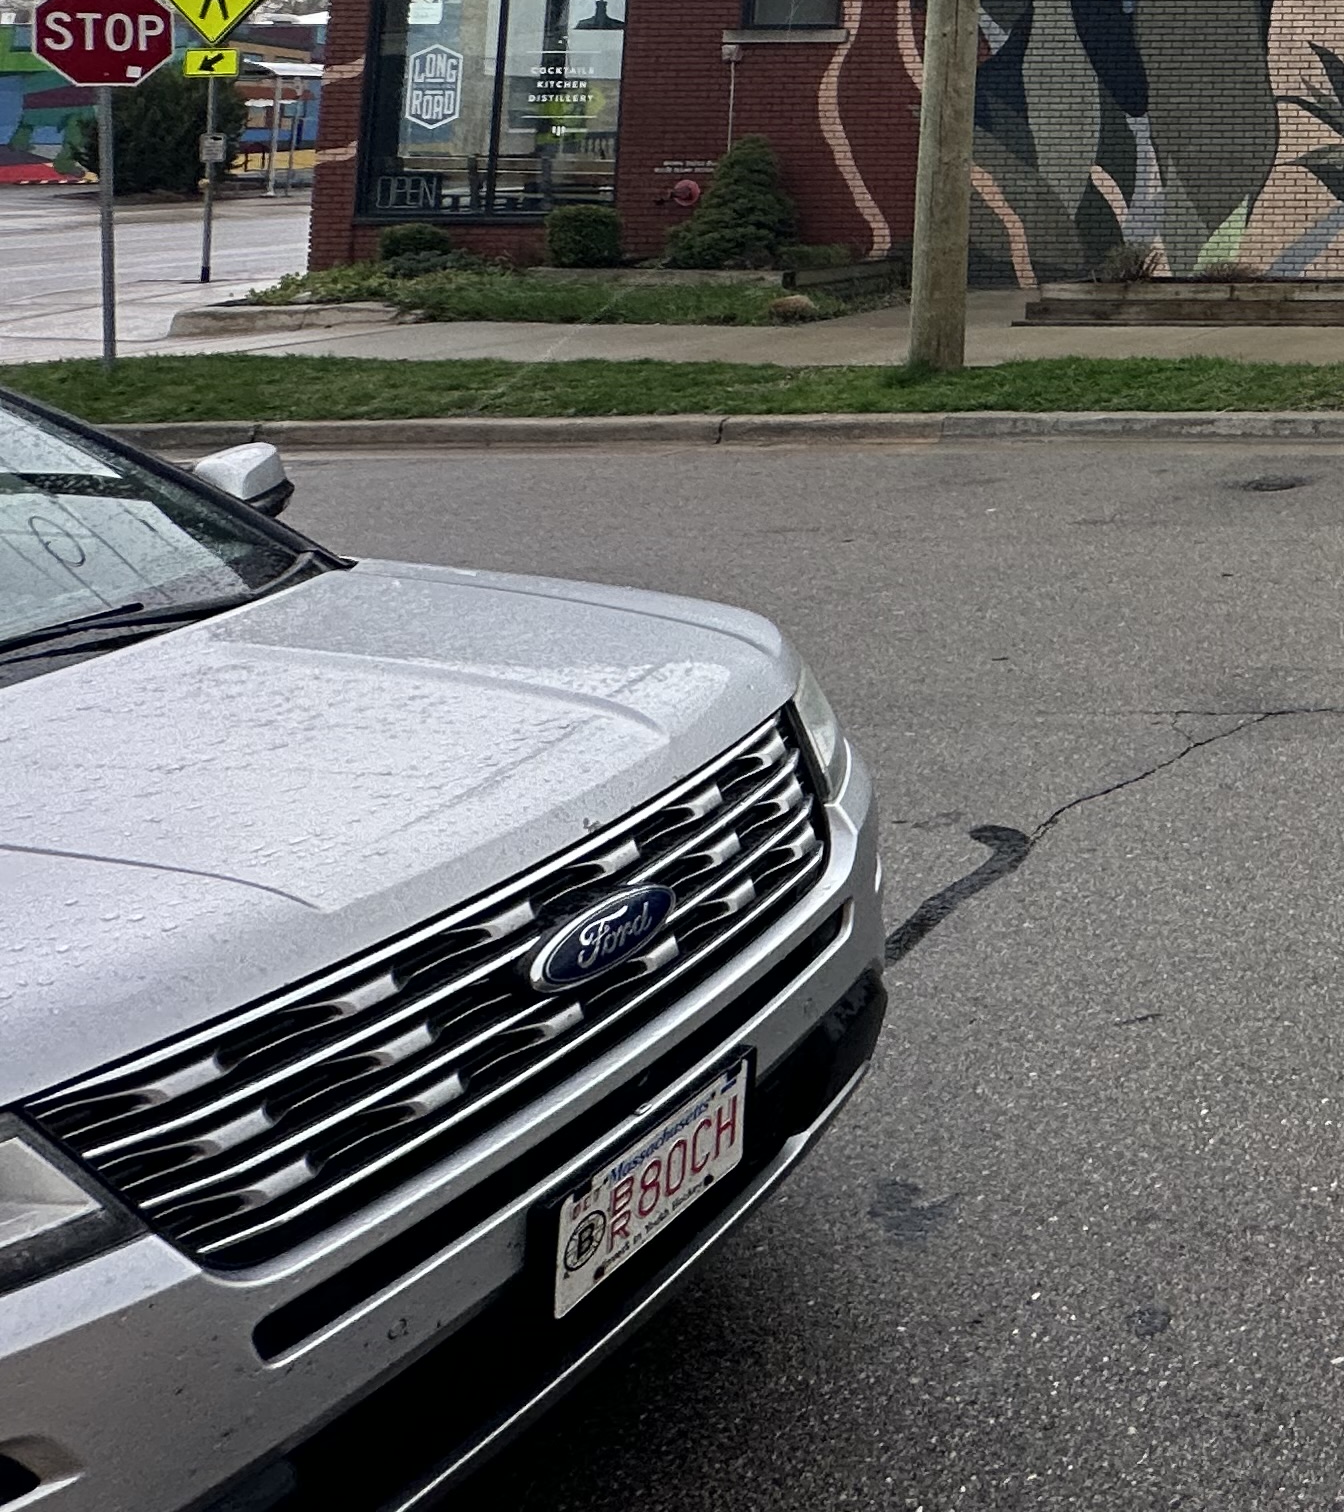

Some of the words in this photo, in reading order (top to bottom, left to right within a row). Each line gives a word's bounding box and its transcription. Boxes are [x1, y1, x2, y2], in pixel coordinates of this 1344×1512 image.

[44, 11, 165, 52] STOP
[413, 53, 458, 82] LONG
[530, 66, 595, 75] COCKTAILS
[527, 94, 594, 103] DISTILLERY
[536, 80, 588, 89] KITCHEN
[411, 90, 455, 120] ROAD
[375, 175, 438, 209] OPEN
[577, 901, 653, 969] Ford
[608, 1099, 711, 1183] Massachusetts
